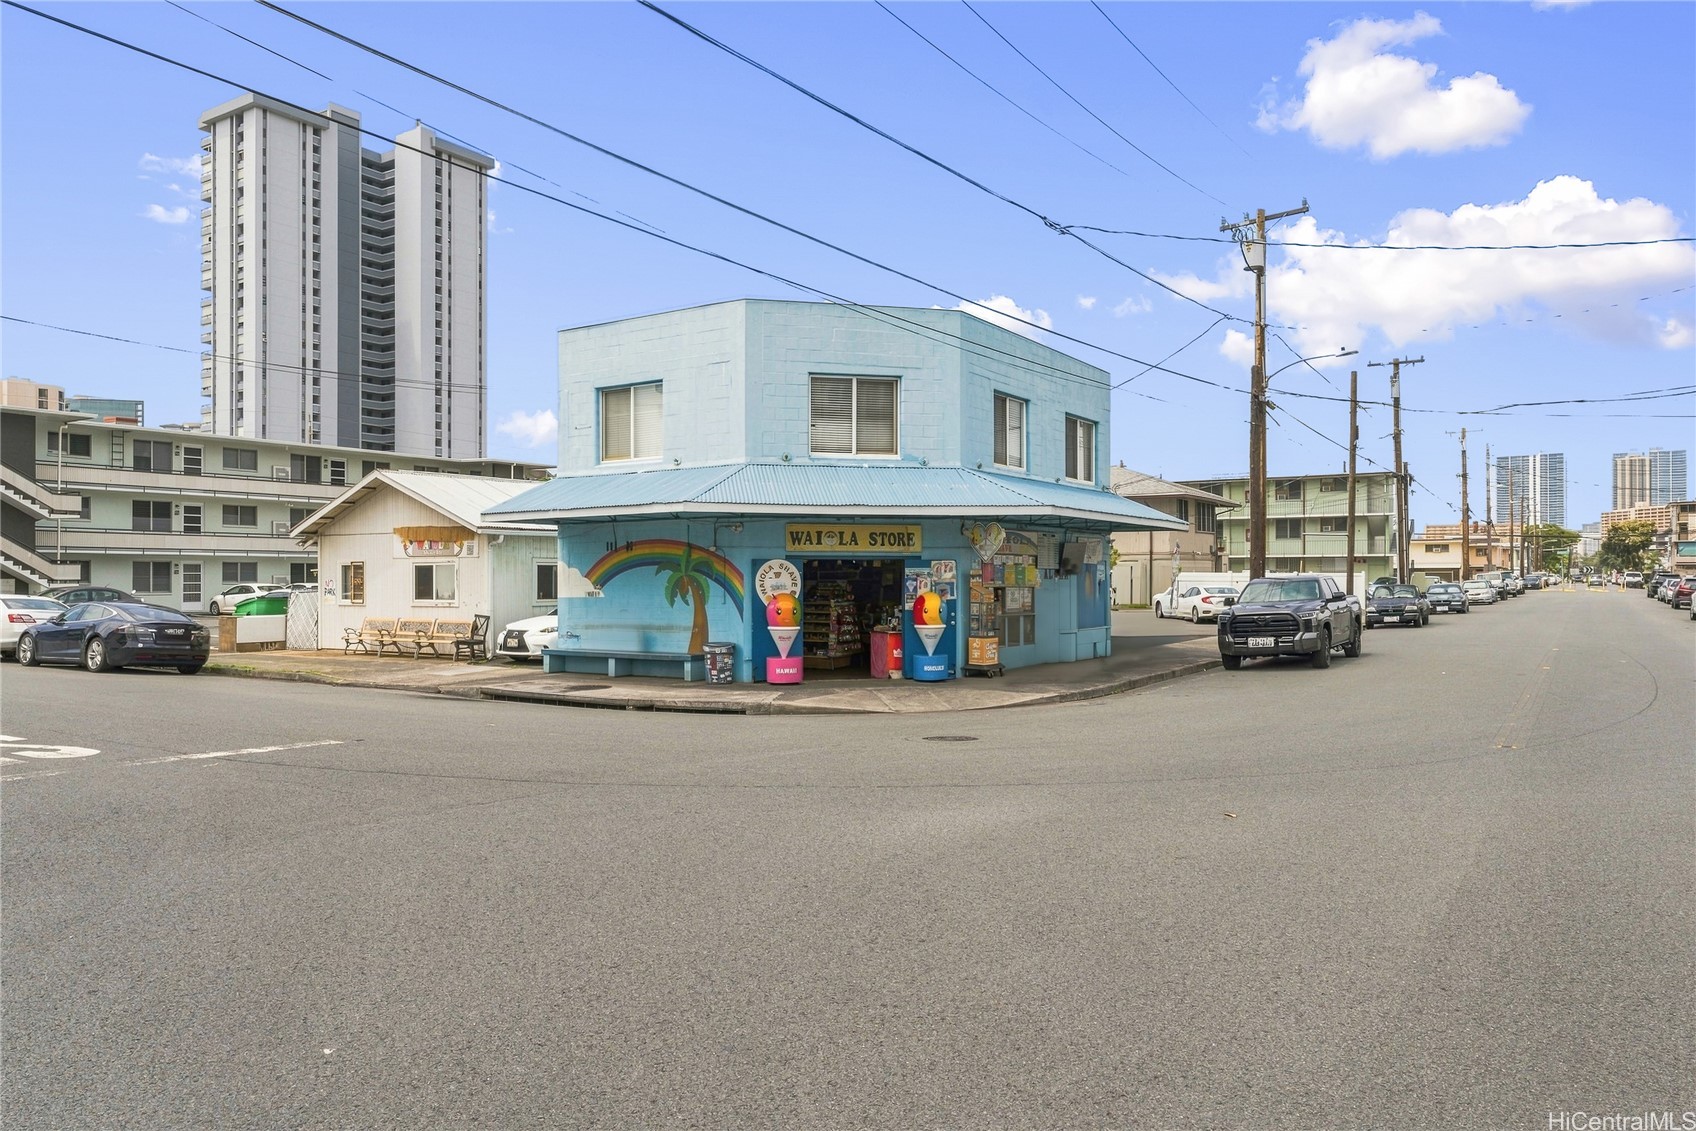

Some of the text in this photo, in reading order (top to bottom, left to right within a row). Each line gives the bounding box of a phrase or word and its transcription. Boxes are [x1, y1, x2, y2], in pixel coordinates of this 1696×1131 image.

[789, 531, 916, 546] WAIOLA STORE
[758, 562, 798, 597] WAIOLA SHAVE
[775, 667, 798, 675] HAWAII
